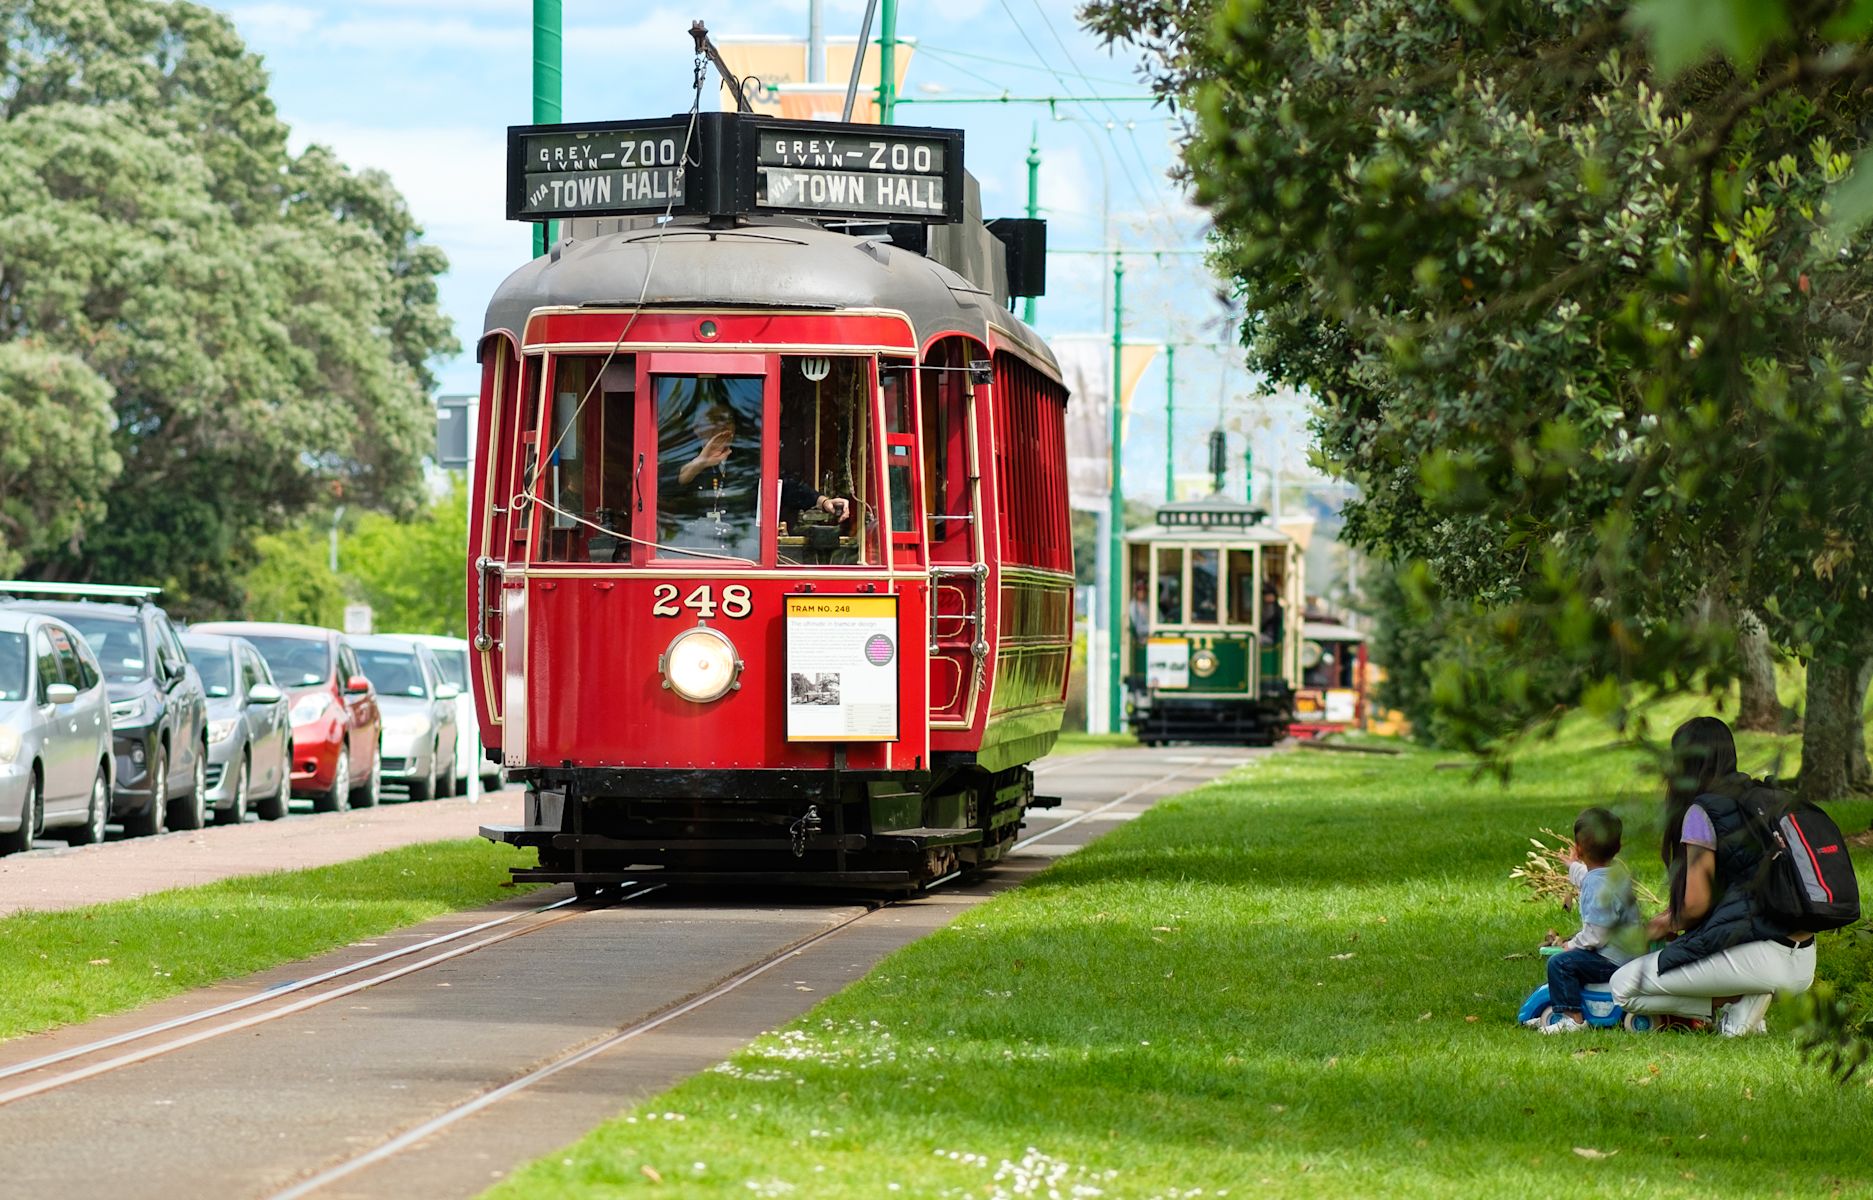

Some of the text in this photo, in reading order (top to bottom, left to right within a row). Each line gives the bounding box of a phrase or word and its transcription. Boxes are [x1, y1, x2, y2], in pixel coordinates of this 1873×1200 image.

[539, 144, 592, 162] GREY
[775, 140, 836, 154] GREY
[783, 154, 843, 167] LYNN
[529, 170, 682, 208] VIA TOWN HALL
[770, 174, 943, 210] VIA TOWN HALL
[652, 584, 753, 619] 248
[791, 605, 815, 613] TRAM
[817, 605, 833, 613] NO.
